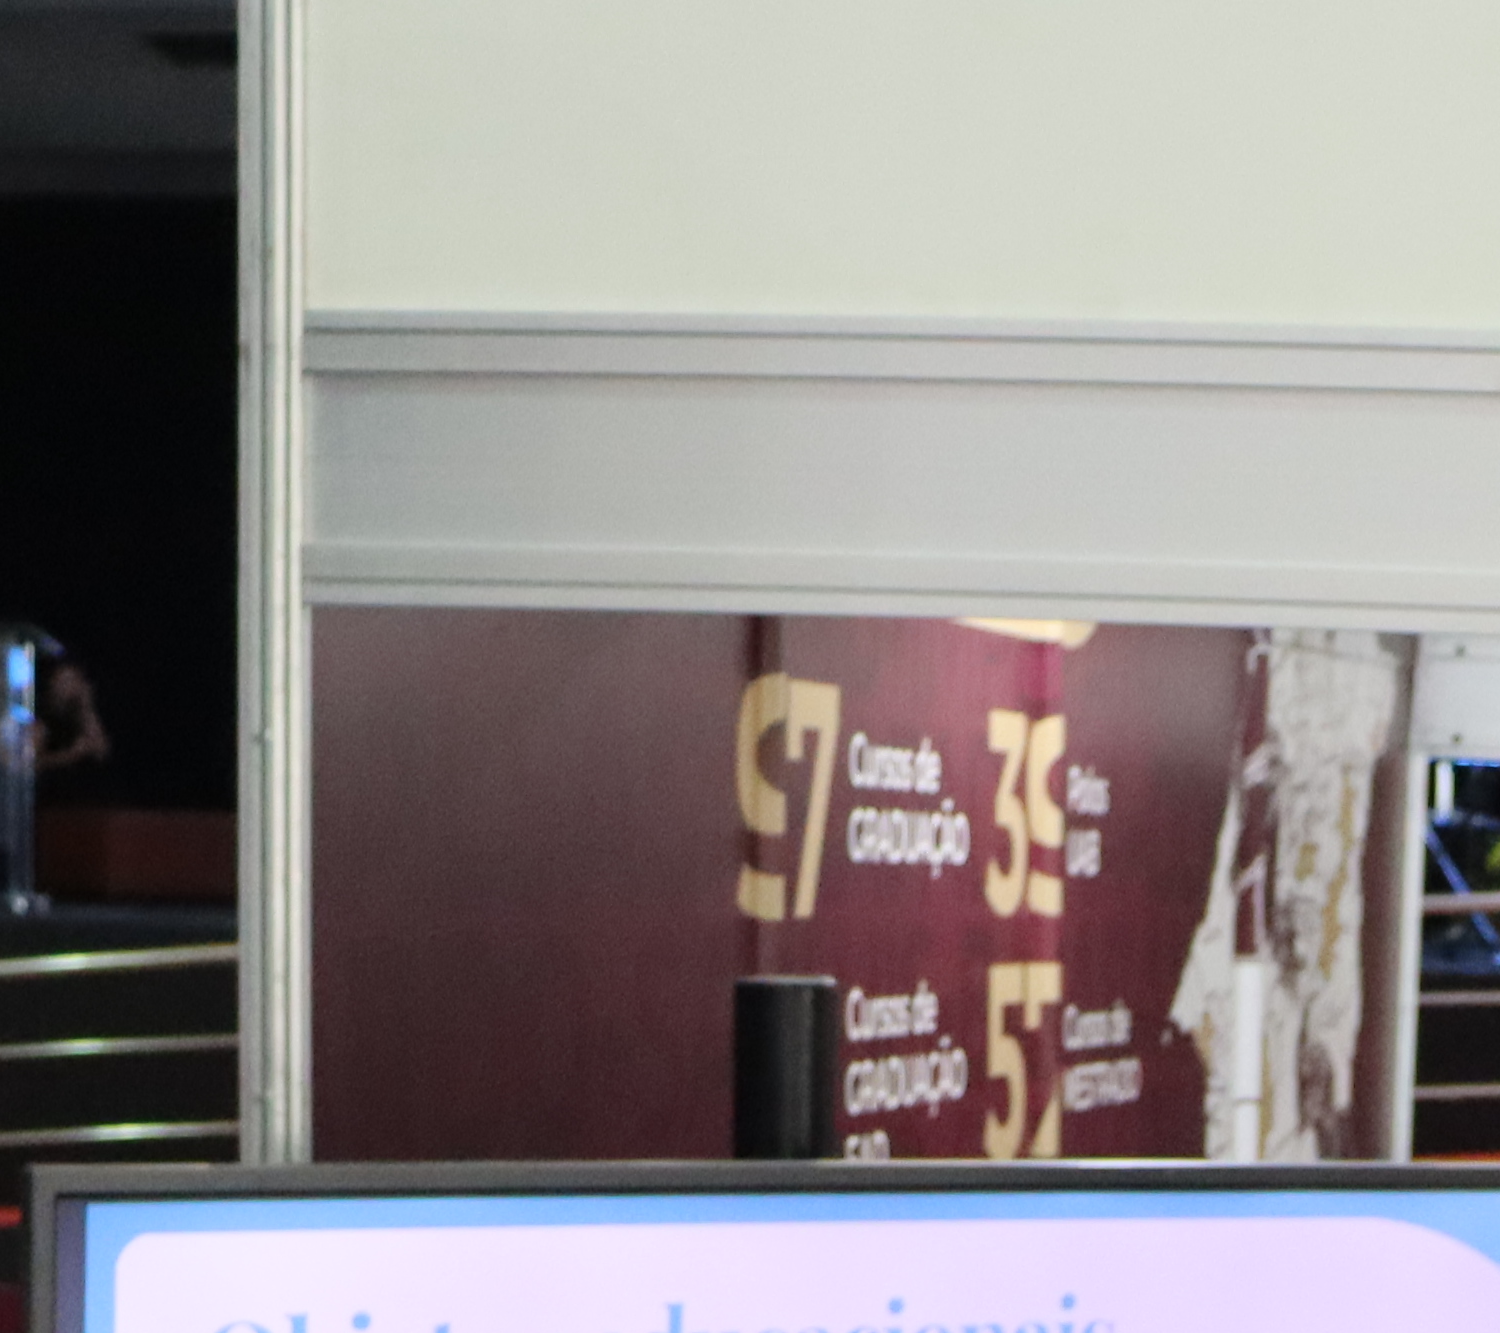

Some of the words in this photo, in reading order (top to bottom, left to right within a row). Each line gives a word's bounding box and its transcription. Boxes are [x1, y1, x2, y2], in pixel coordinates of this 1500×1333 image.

[848, 731, 914, 793] Cursos
[847, 797, 971, 880] GRADUAÇÃO
[845, 985, 911, 1042] Cursos
[844, 1034, 969, 1119] GRADUAÇÃO
